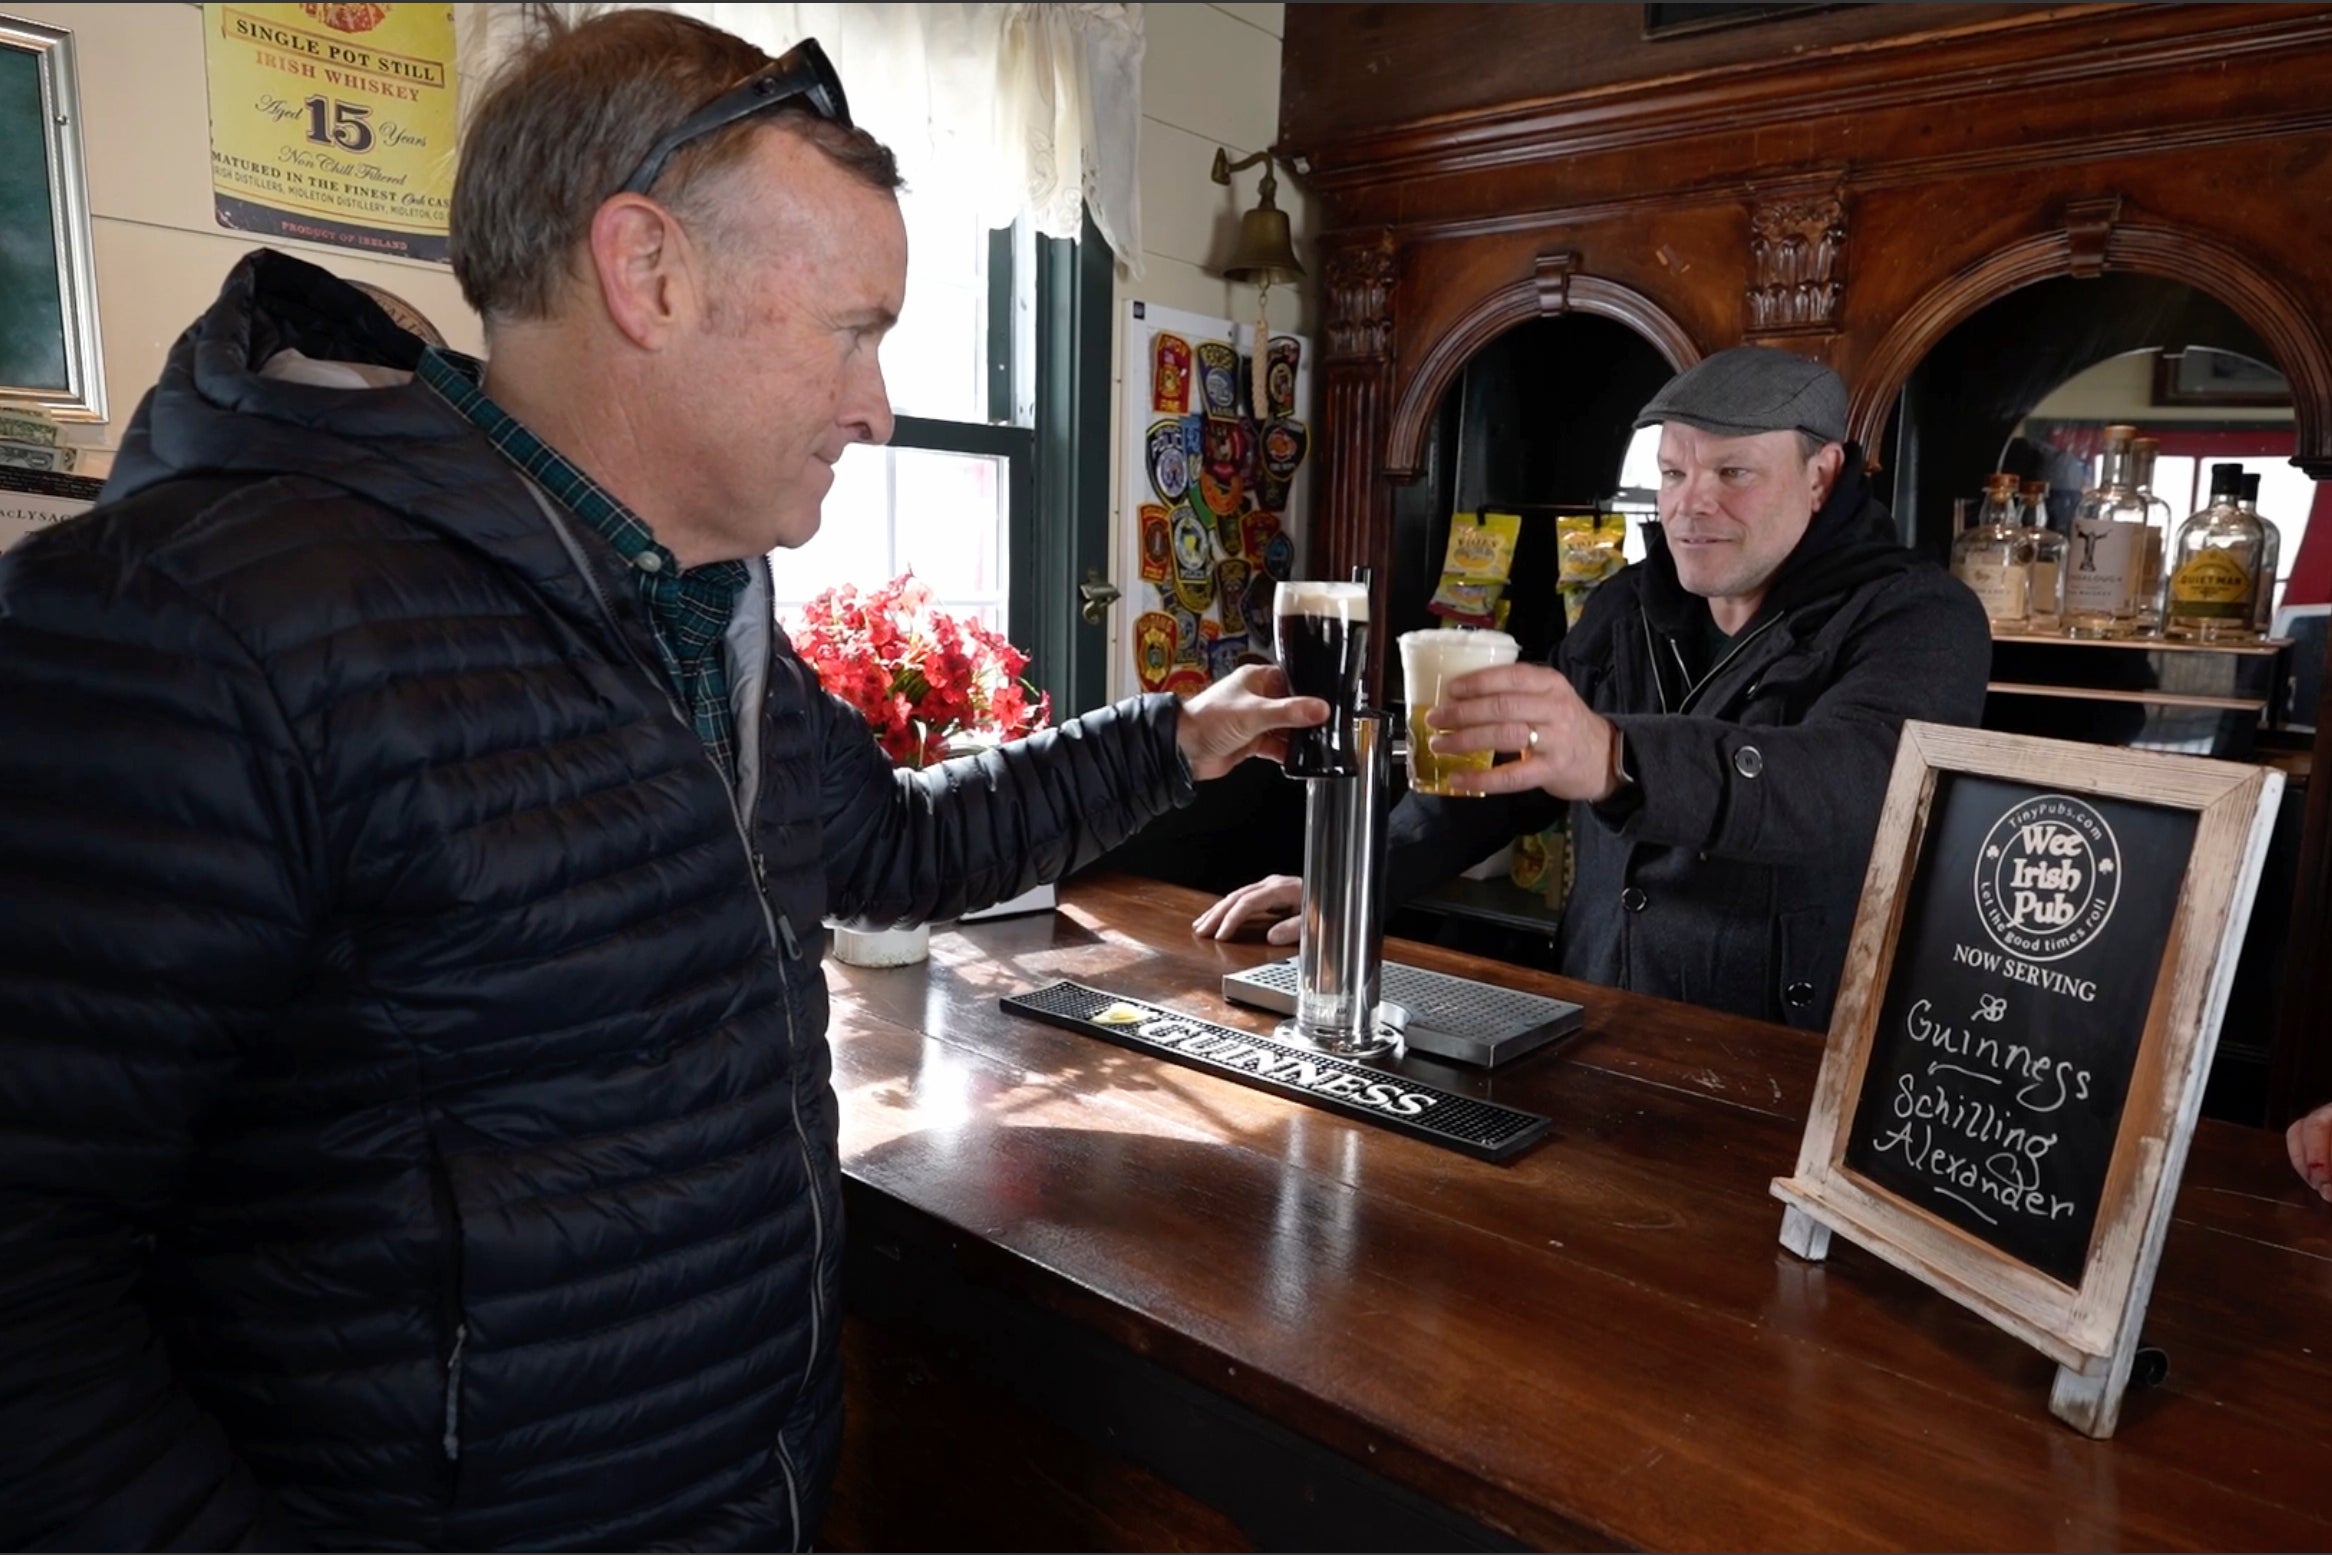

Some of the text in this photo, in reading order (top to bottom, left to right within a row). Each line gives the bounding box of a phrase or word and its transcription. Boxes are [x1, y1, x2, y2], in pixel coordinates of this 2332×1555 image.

[236, 19, 435, 81] SINGLE POT STILL
[256, 51, 420, 102] IRISH WHISKEY
[254, 94, 428, 155] Aged 15 Years
[210, 151, 281, 178] MATURED
[286, 171, 303, 183] IN
[307, 176, 339, 192] THE
[344, 184, 398, 201] FINEST
[427, 197, 450, 208] CAS
[277, 145, 408, 186] Non Chill Filtered
[281, 221, 408, 250] PRODUCT OF IRELAND
[1150, 433, 1183, 460] POLIC
[2008, 803, 2103, 841] TinyPubs.com
[2021, 825, 2084, 857] Wee
[2010, 858, 2082, 892] Irish
[1980, 880, 2106, 952] Let the good times roll
[2007, 890, 2075, 928] Pub
[1953, 944, 2097, 1002] NOW SERVING
[1138, 1020, 1438, 1115] GUINNESS
[1907, 999, 2091, 1112] Guinness
[1894, 1073, 2058, 1190] Schilling
[1873, 1121, 2075, 1220] Alexander
